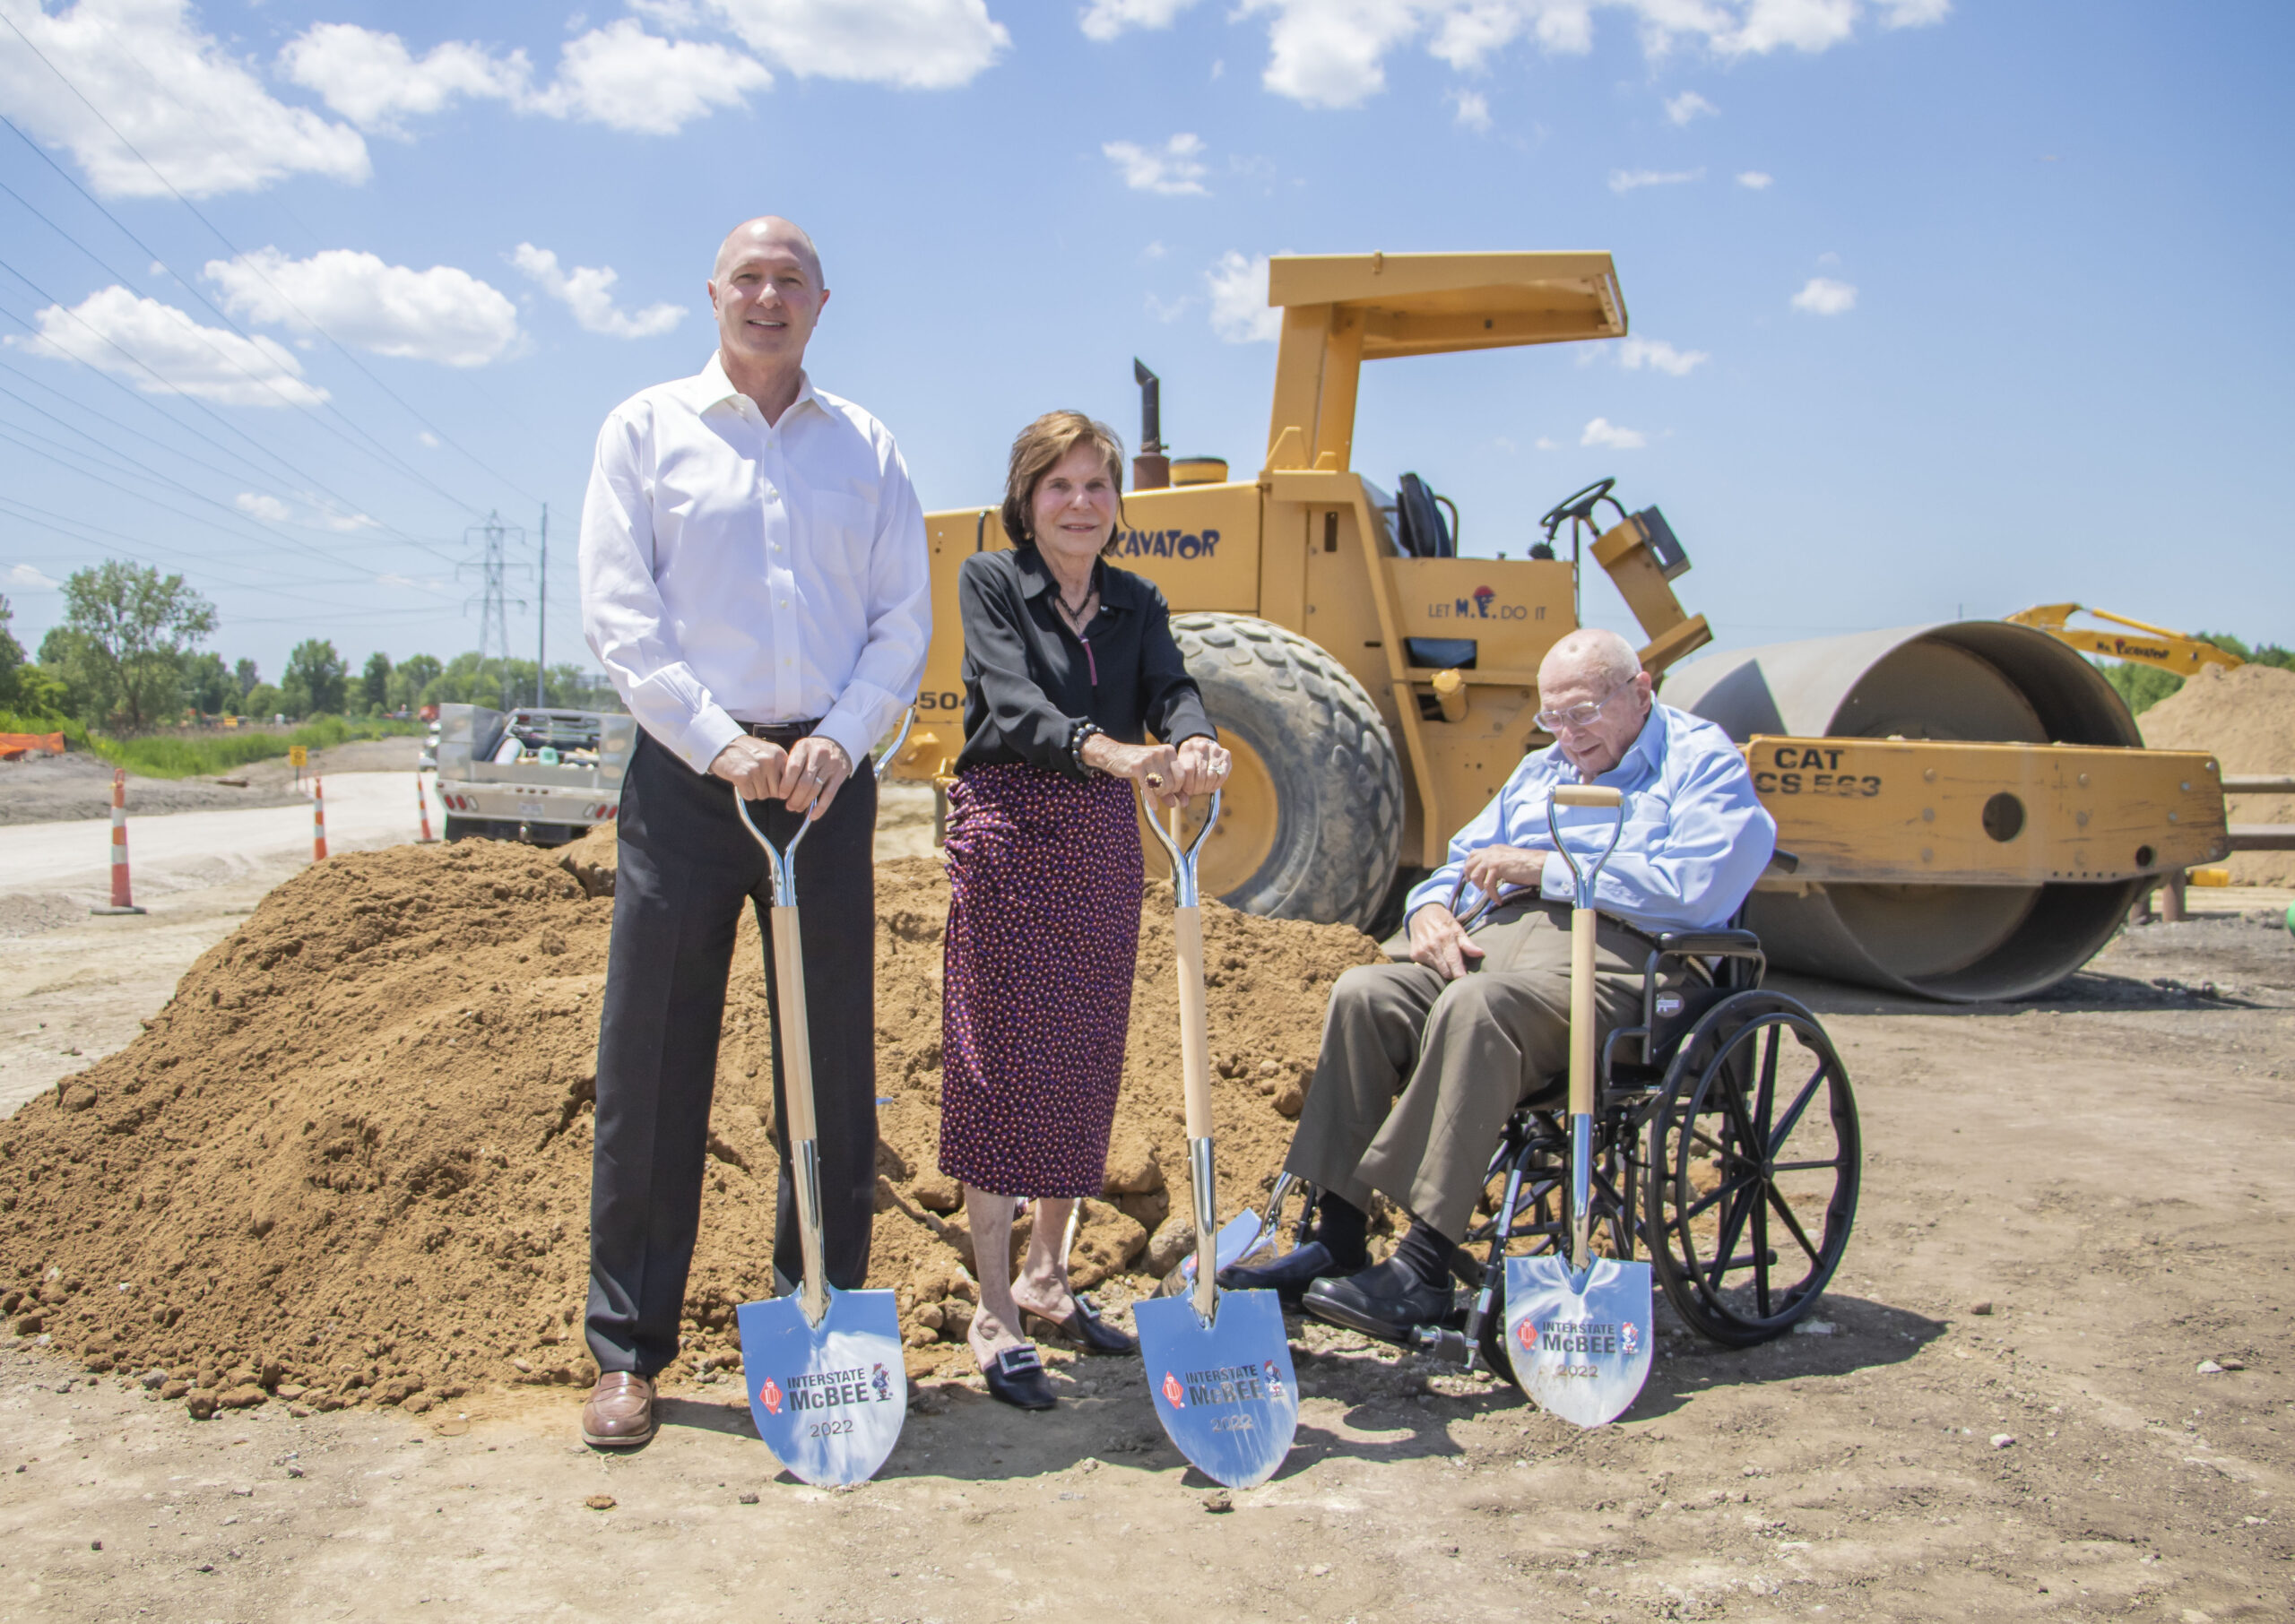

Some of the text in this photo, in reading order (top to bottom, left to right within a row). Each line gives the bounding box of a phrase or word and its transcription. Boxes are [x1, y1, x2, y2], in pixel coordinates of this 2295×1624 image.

[1427, 603, 1451, 618] LET
[1500, 605, 1529, 620] DO
[1534, 606, 1547, 620] IT
[1773, 747, 1844, 771] CAT
[1754, 772, 1803, 795] CS
[1542, 1321, 1615, 1335] INTERSTATE
[786, 1368, 866, 1390] INTERSTATE
[1185, 1364, 1259, 1385] INTERSTATE
[1555, 1363, 1598, 1378] 2022
[810, 1419, 854, 1438] 2022
[1211, 1413, 1254, 1434] 2022
